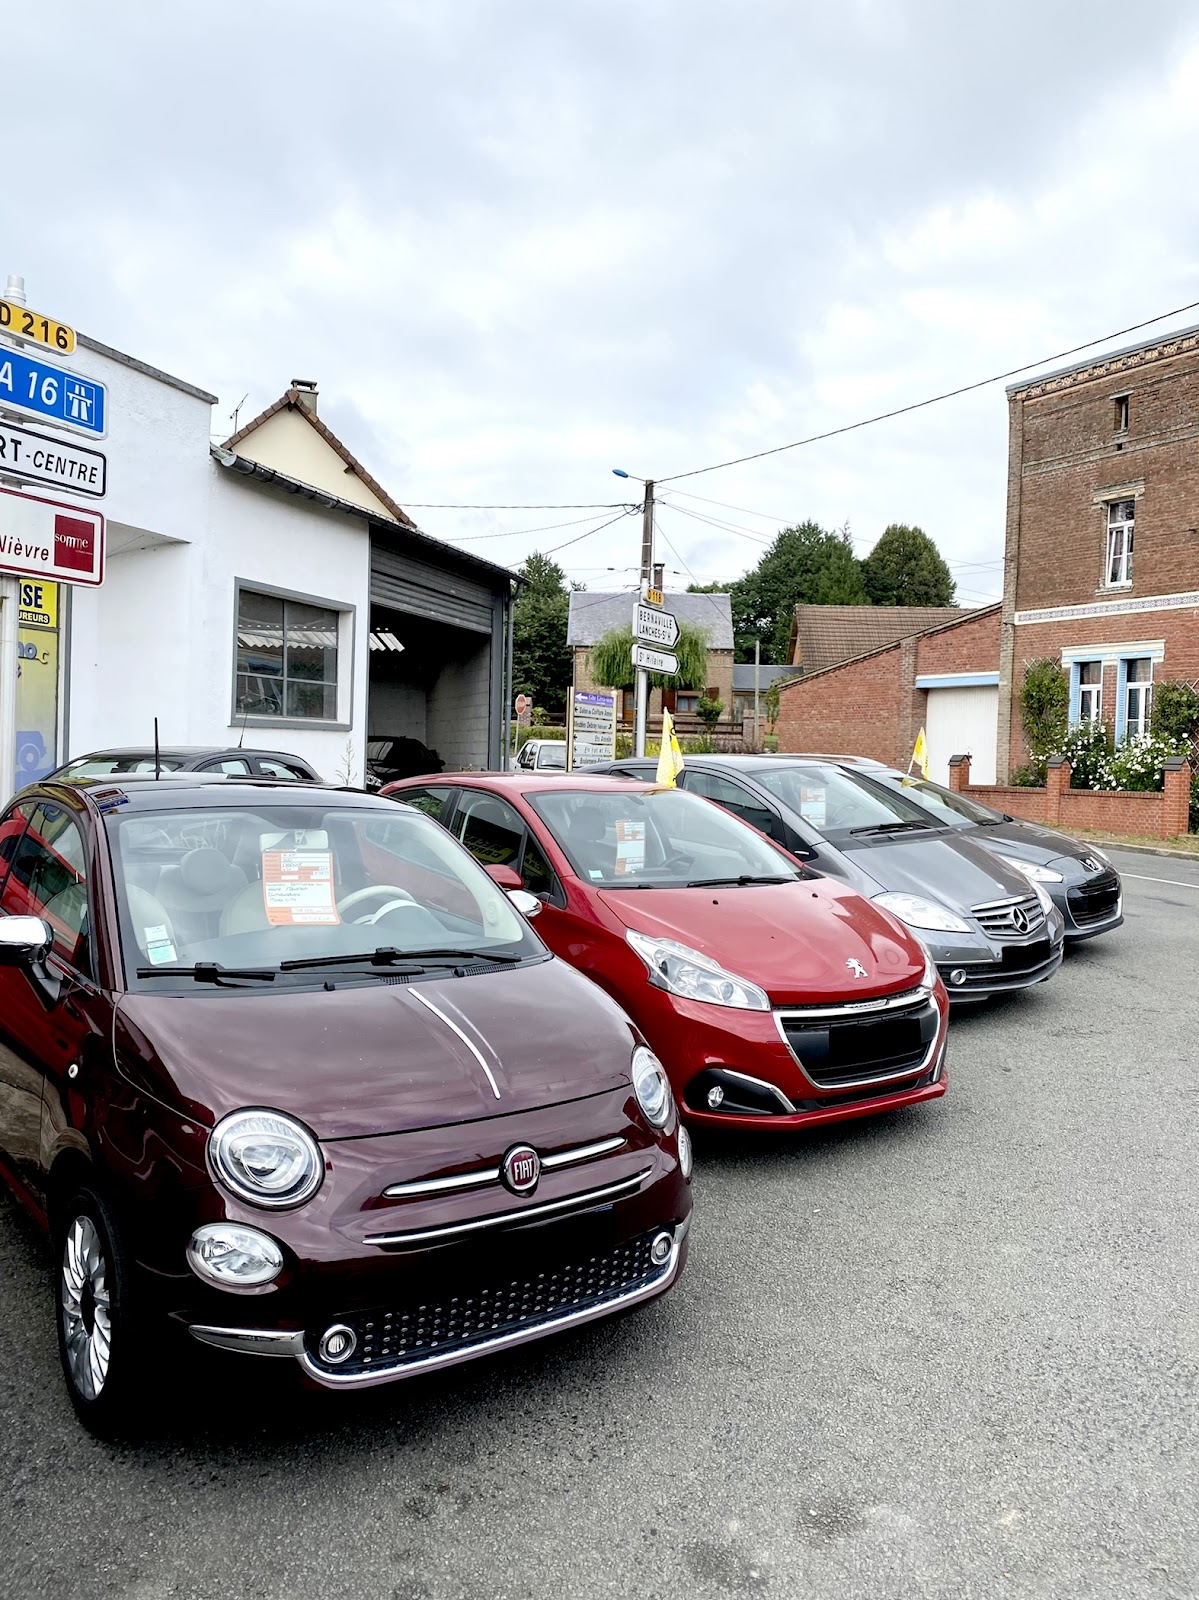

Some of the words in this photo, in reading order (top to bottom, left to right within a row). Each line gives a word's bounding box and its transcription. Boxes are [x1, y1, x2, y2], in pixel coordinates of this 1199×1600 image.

[0, 302, 11, 326] D
[22, 312, 68, 349] 216
[0, 361, 13, 392] A
[28, 371, 59, 406] 16
[55, 533, 89, 550] somme
[639, 610, 673, 630] BERNAVILLE
[645, 653, 664, 667] Hilaire
[513, 1158, 533, 1181] FIAT
